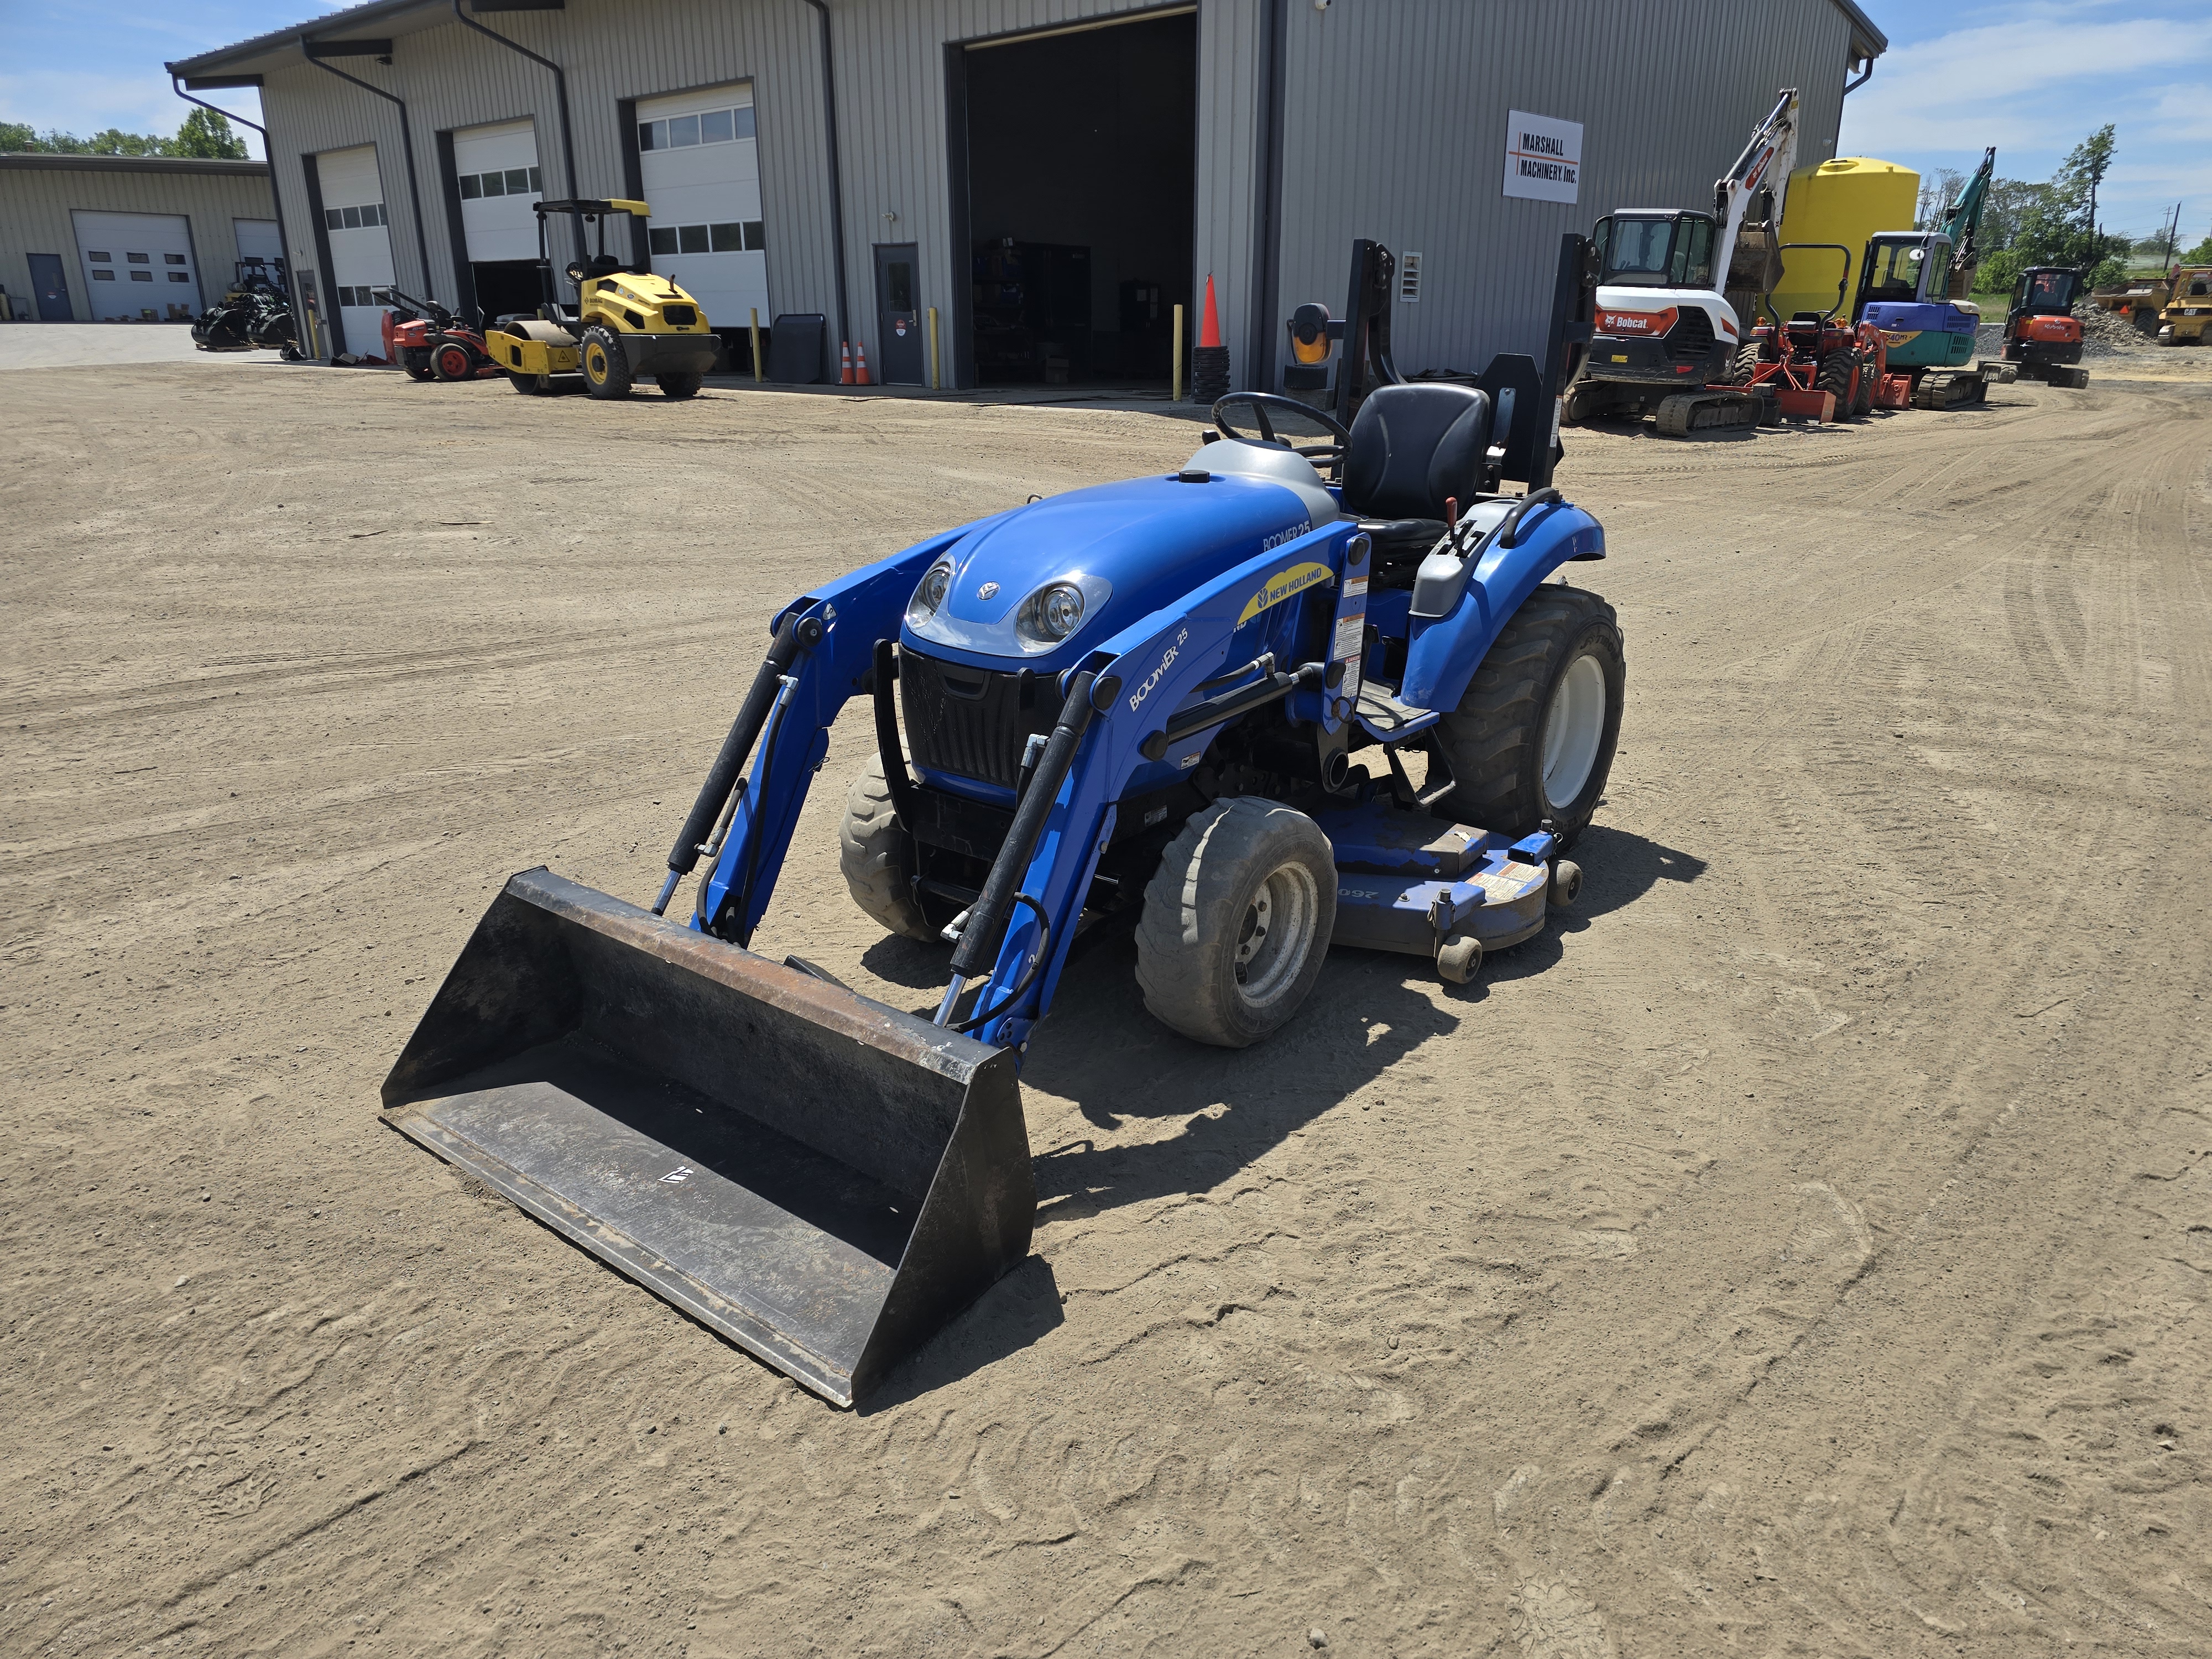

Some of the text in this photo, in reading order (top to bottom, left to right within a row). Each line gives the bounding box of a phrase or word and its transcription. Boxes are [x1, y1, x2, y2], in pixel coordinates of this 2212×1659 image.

[1522, 133, 1563, 156] MARSHALL
[1521, 160, 1577, 184] MACHINERY, Inc.
[1616, 317, 1647, 328] Bobcat
[1263, 520, 1310, 552] BOOMER 25
[1270, 583, 1287, 602] NEW
[1288, 567, 1322, 593] HOLLAND
[1177, 628, 1188, 646] 25
